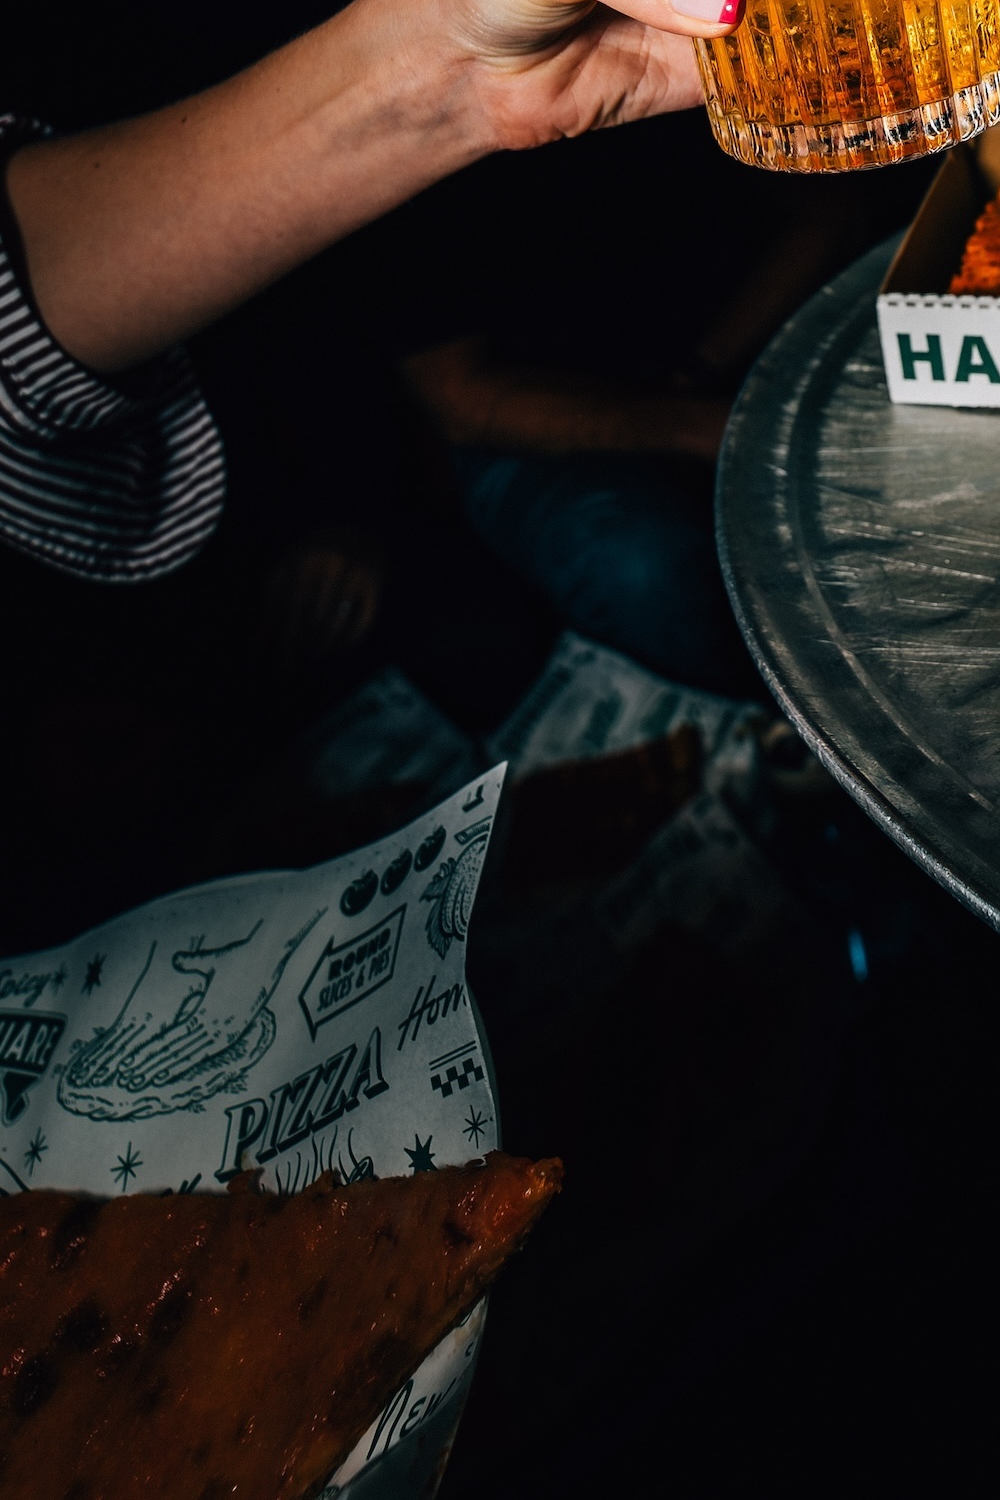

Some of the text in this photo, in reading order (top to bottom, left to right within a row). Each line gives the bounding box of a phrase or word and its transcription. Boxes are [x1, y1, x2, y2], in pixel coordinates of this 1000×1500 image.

[317, 971, 355, 1012] SLICES
[367, 945, 392, 981] PIES
[328, 928, 391, 981] ROUND
[397, 974, 467, 1051] Hom
[214, 1025, 389, 1184] PIZZA
